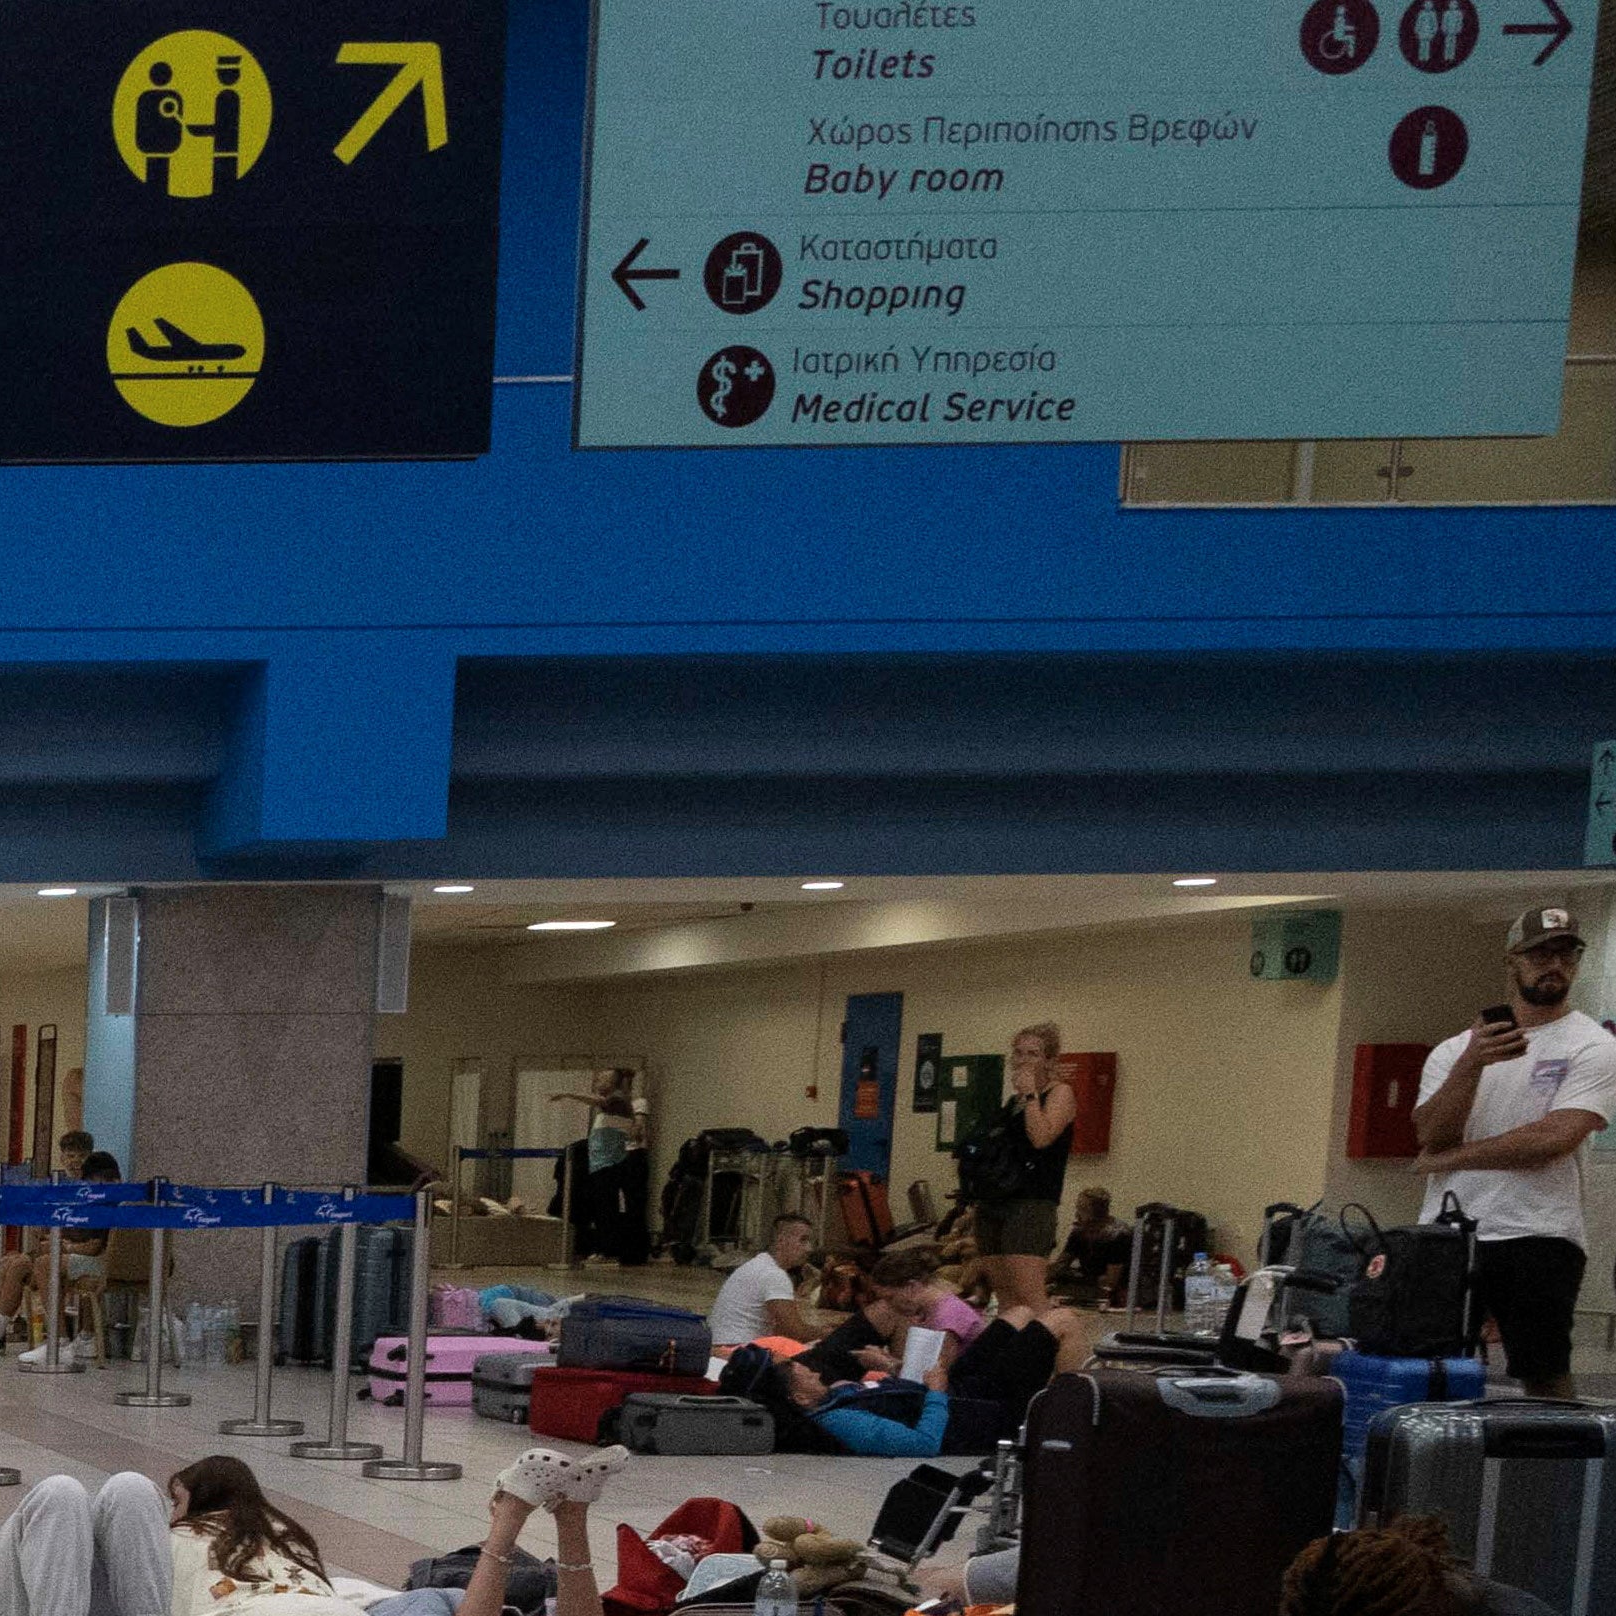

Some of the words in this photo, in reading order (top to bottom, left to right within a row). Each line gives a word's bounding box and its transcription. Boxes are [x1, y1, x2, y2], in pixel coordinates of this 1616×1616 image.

[816, 0, 975, 29] Τουαλέτες
[812, 47, 936, 81] Toilets
[807, 115, 912, 152] Χώρος
[923, 113, 1117, 150] Περιποίησης
[1128, 110, 1258, 147] Βρεφών
[804, 163, 899, 201] Baby
[908, 168, 1005, 193] room
[800, 231, 997, 264] Καταστήματα
[798, 279, 966, 316] Shopping
[793, 343, 899, 378] Ιατρική
[911, 343, 1056, 378] Υπηρεσία
[791, 391, 931, 424] Medical
[942, 390, 1076, 423] Service
